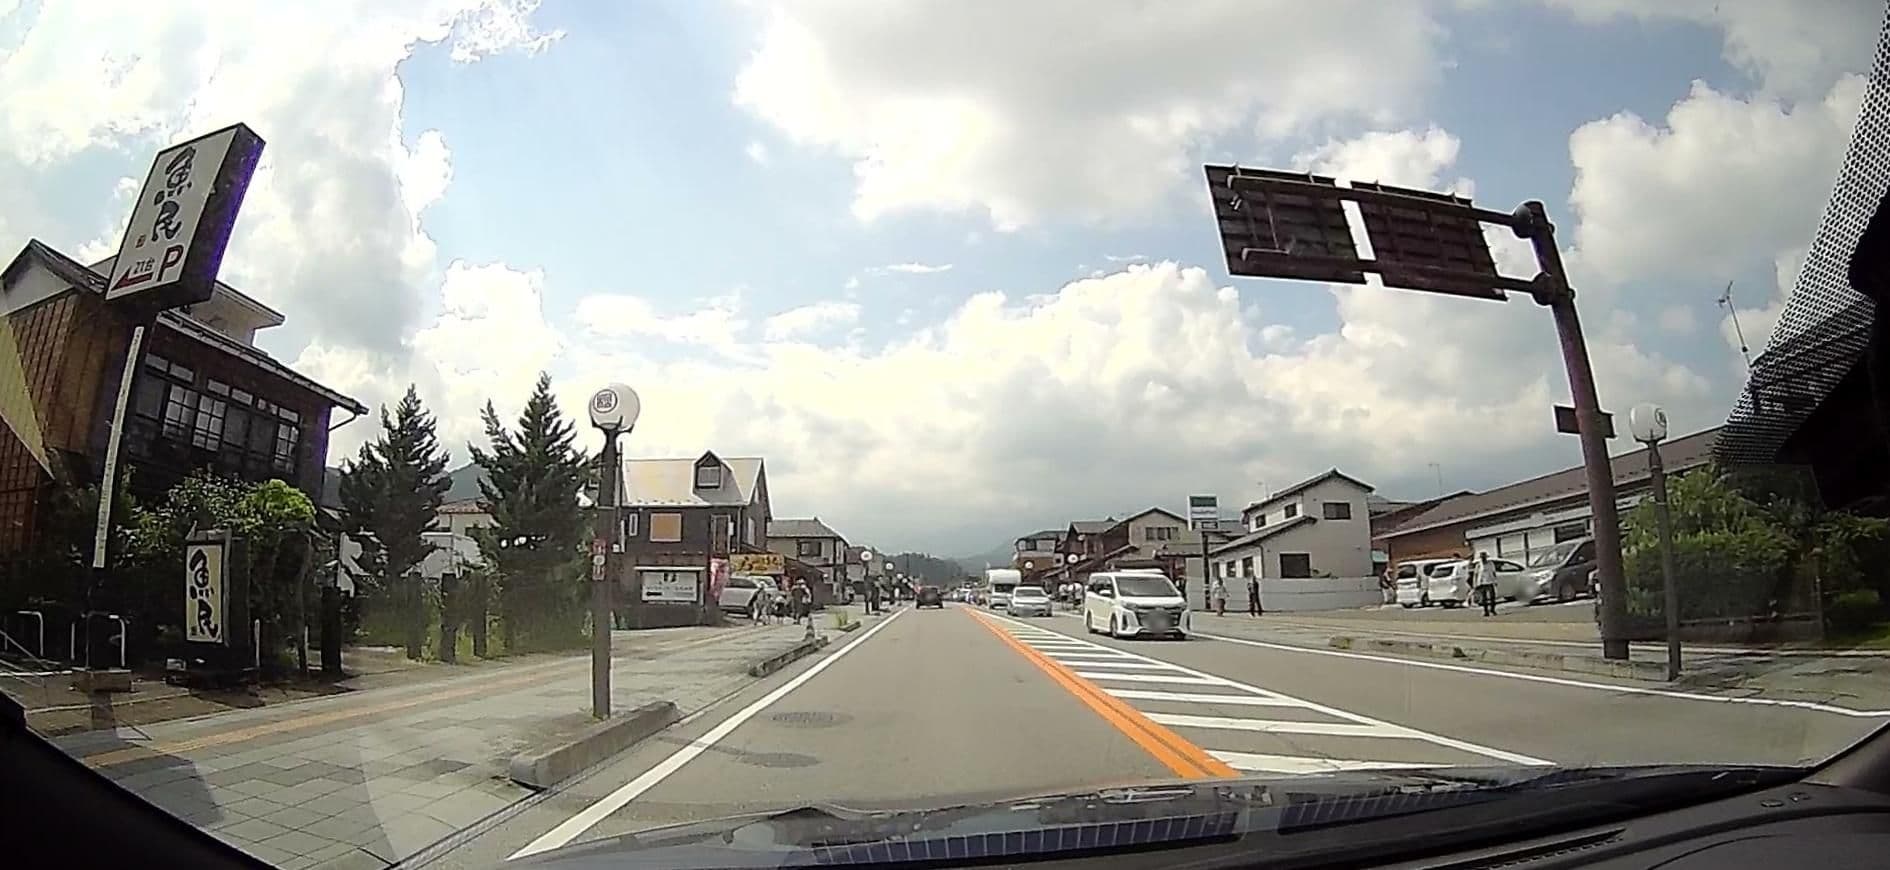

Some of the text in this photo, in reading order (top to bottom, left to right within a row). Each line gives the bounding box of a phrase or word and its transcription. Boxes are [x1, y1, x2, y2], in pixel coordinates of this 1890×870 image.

[152, 146, 197, 241] 魚民
[157, 244, 184, 281] P
[189, 549, 219, 639] 魚民
